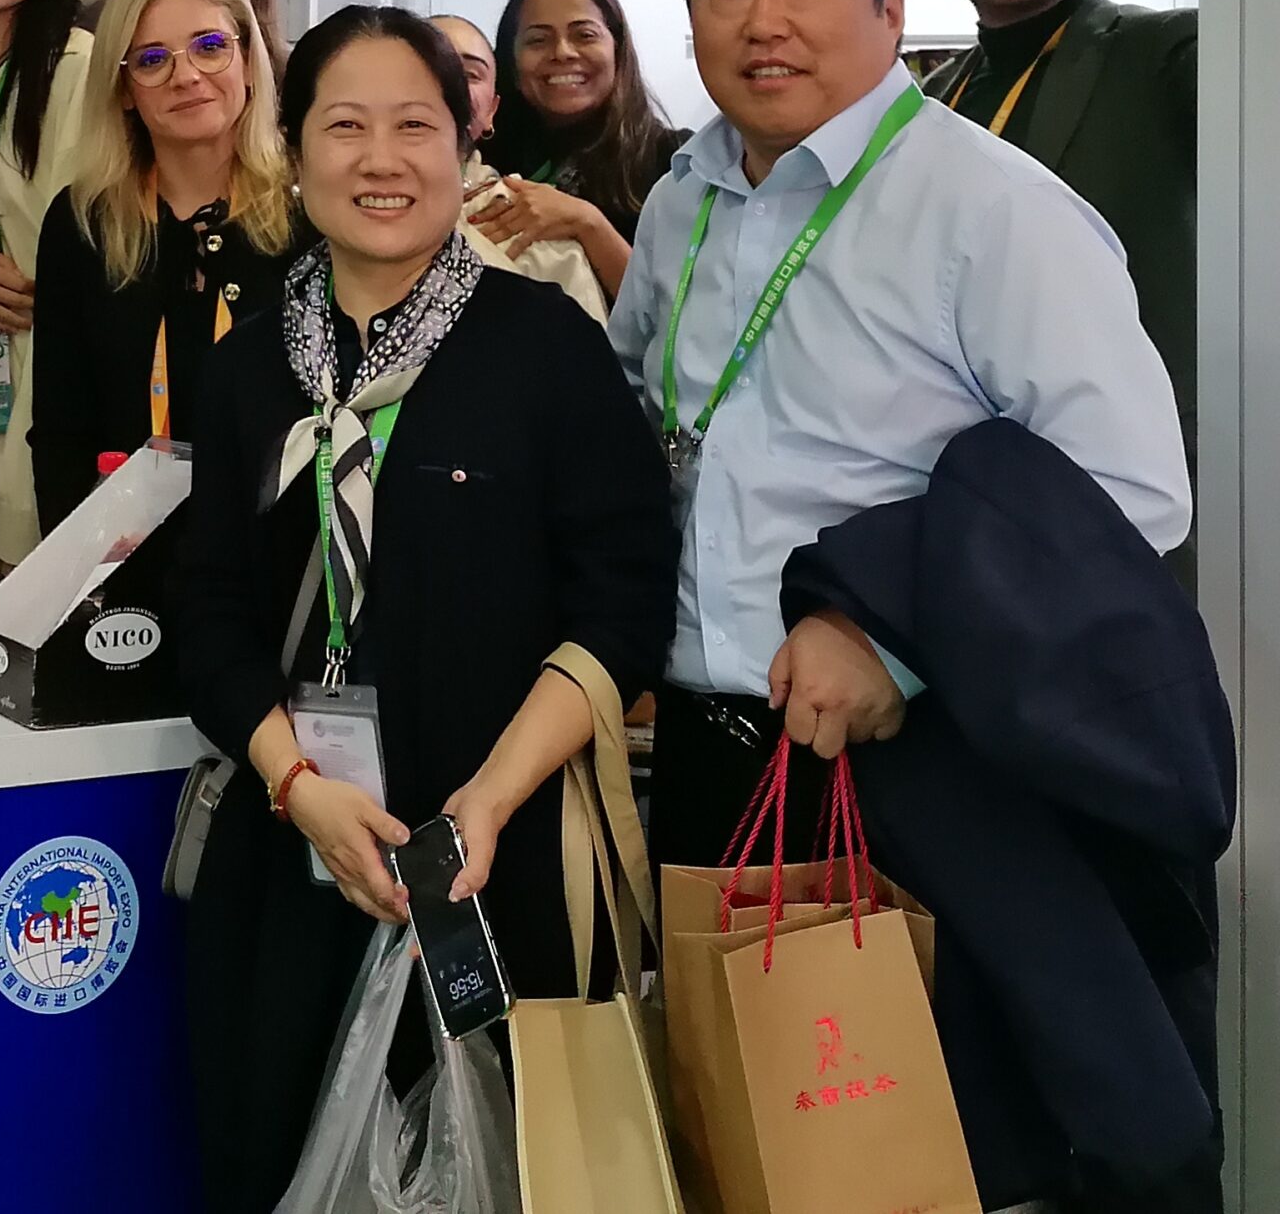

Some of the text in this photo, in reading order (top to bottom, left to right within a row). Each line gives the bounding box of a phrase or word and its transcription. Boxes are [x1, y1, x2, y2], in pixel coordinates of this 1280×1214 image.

[745, 228, 819, 342] 中国国际进口博览会
[94, 628, 153, 649] NICO
[3, 847, 89, 899] INTERNATIONAL
[91, 852, 126, 890] IMPORT
[120, 891, 132, 928] EXPO
[24, 904, 100, 944] CIIE
[448, 967, 486, 1002] 15:56
